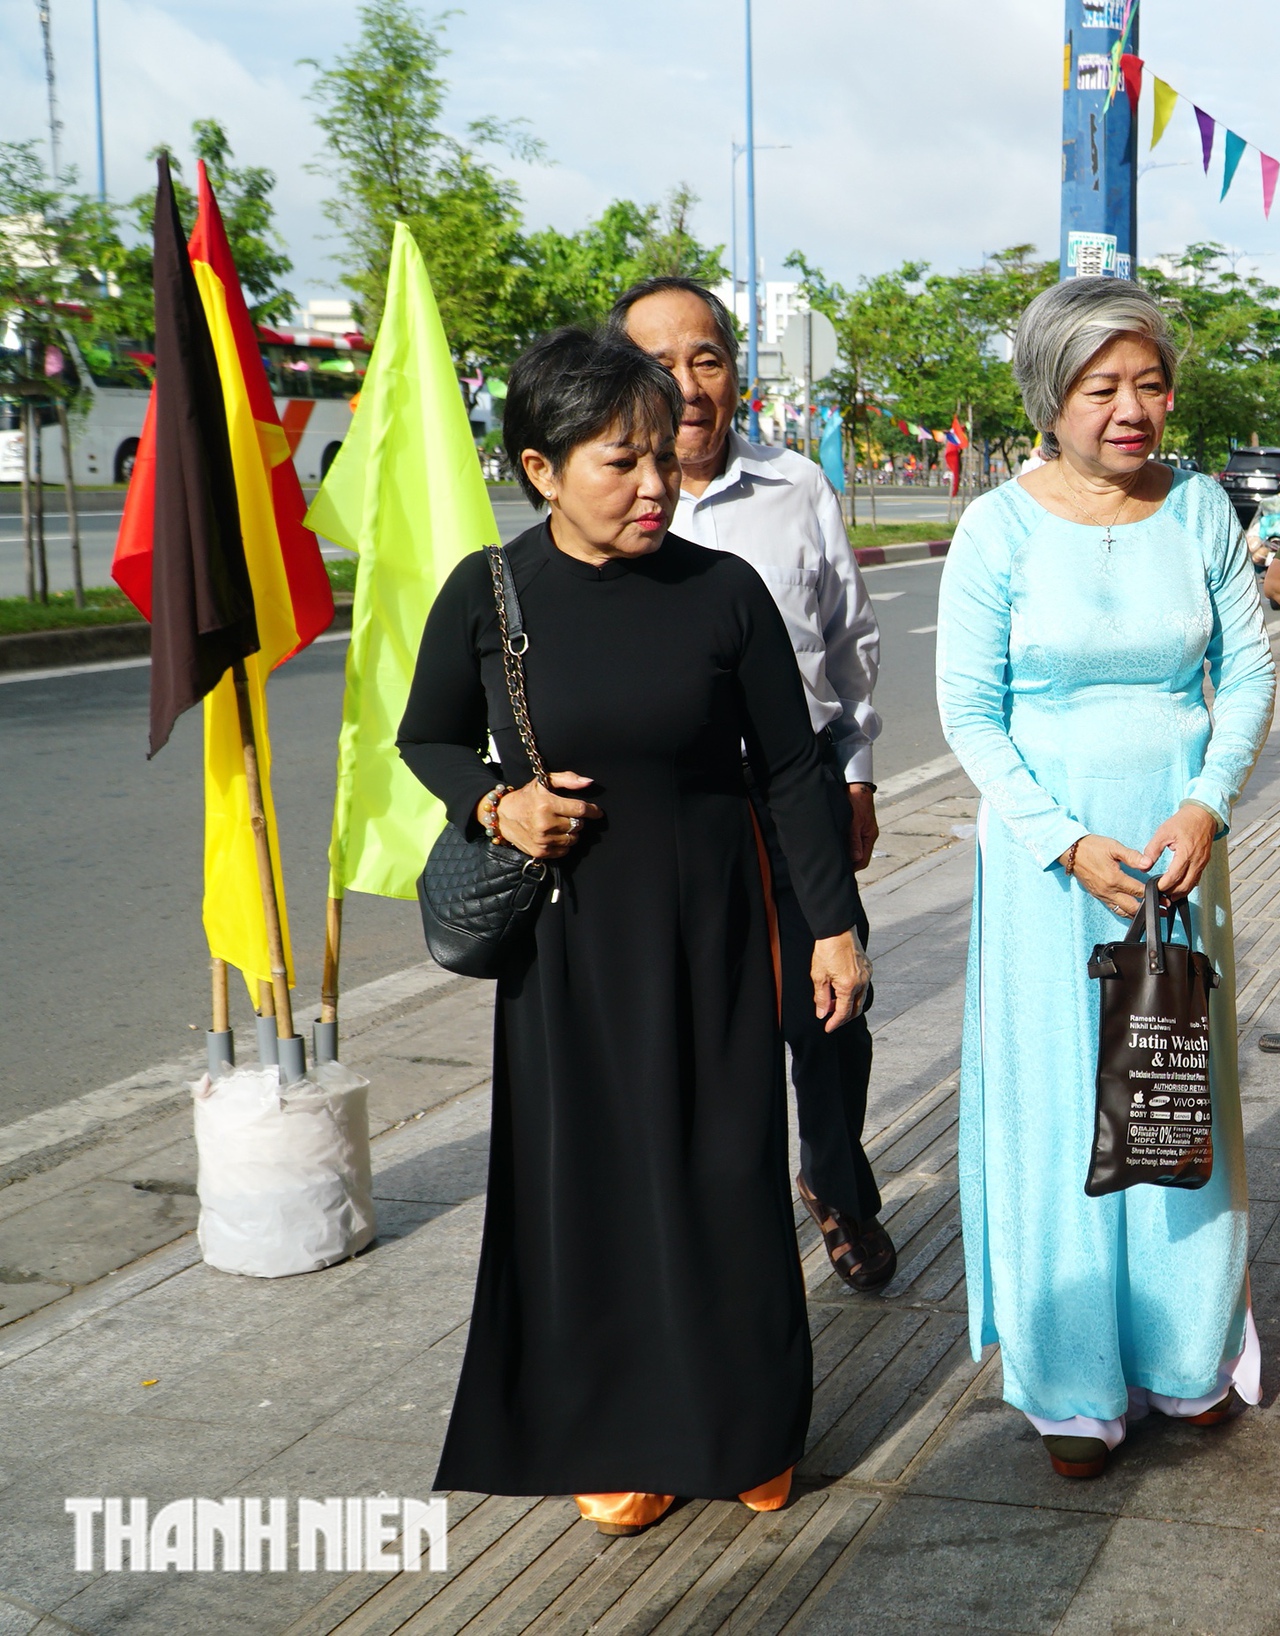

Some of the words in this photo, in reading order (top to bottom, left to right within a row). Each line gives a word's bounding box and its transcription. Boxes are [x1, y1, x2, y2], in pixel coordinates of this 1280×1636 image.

[1130, 1014, 1156, 1023] Ramesh
[1128, 1033, 1168, 1050] Jatin
[1151, 1051, 1165, 1067] &
[1153, 1083, 1189, 1091] AUTHORISED
[1129, 1110, 1147, 1118] SONY
[1159, 1126, 1173, 1144] 0%
[1131, 1147, 1145, 1155] Shree
[1145, 1147, 1156, 1155] Ram
[1156, 1147, 1178, 1157] Complex,
